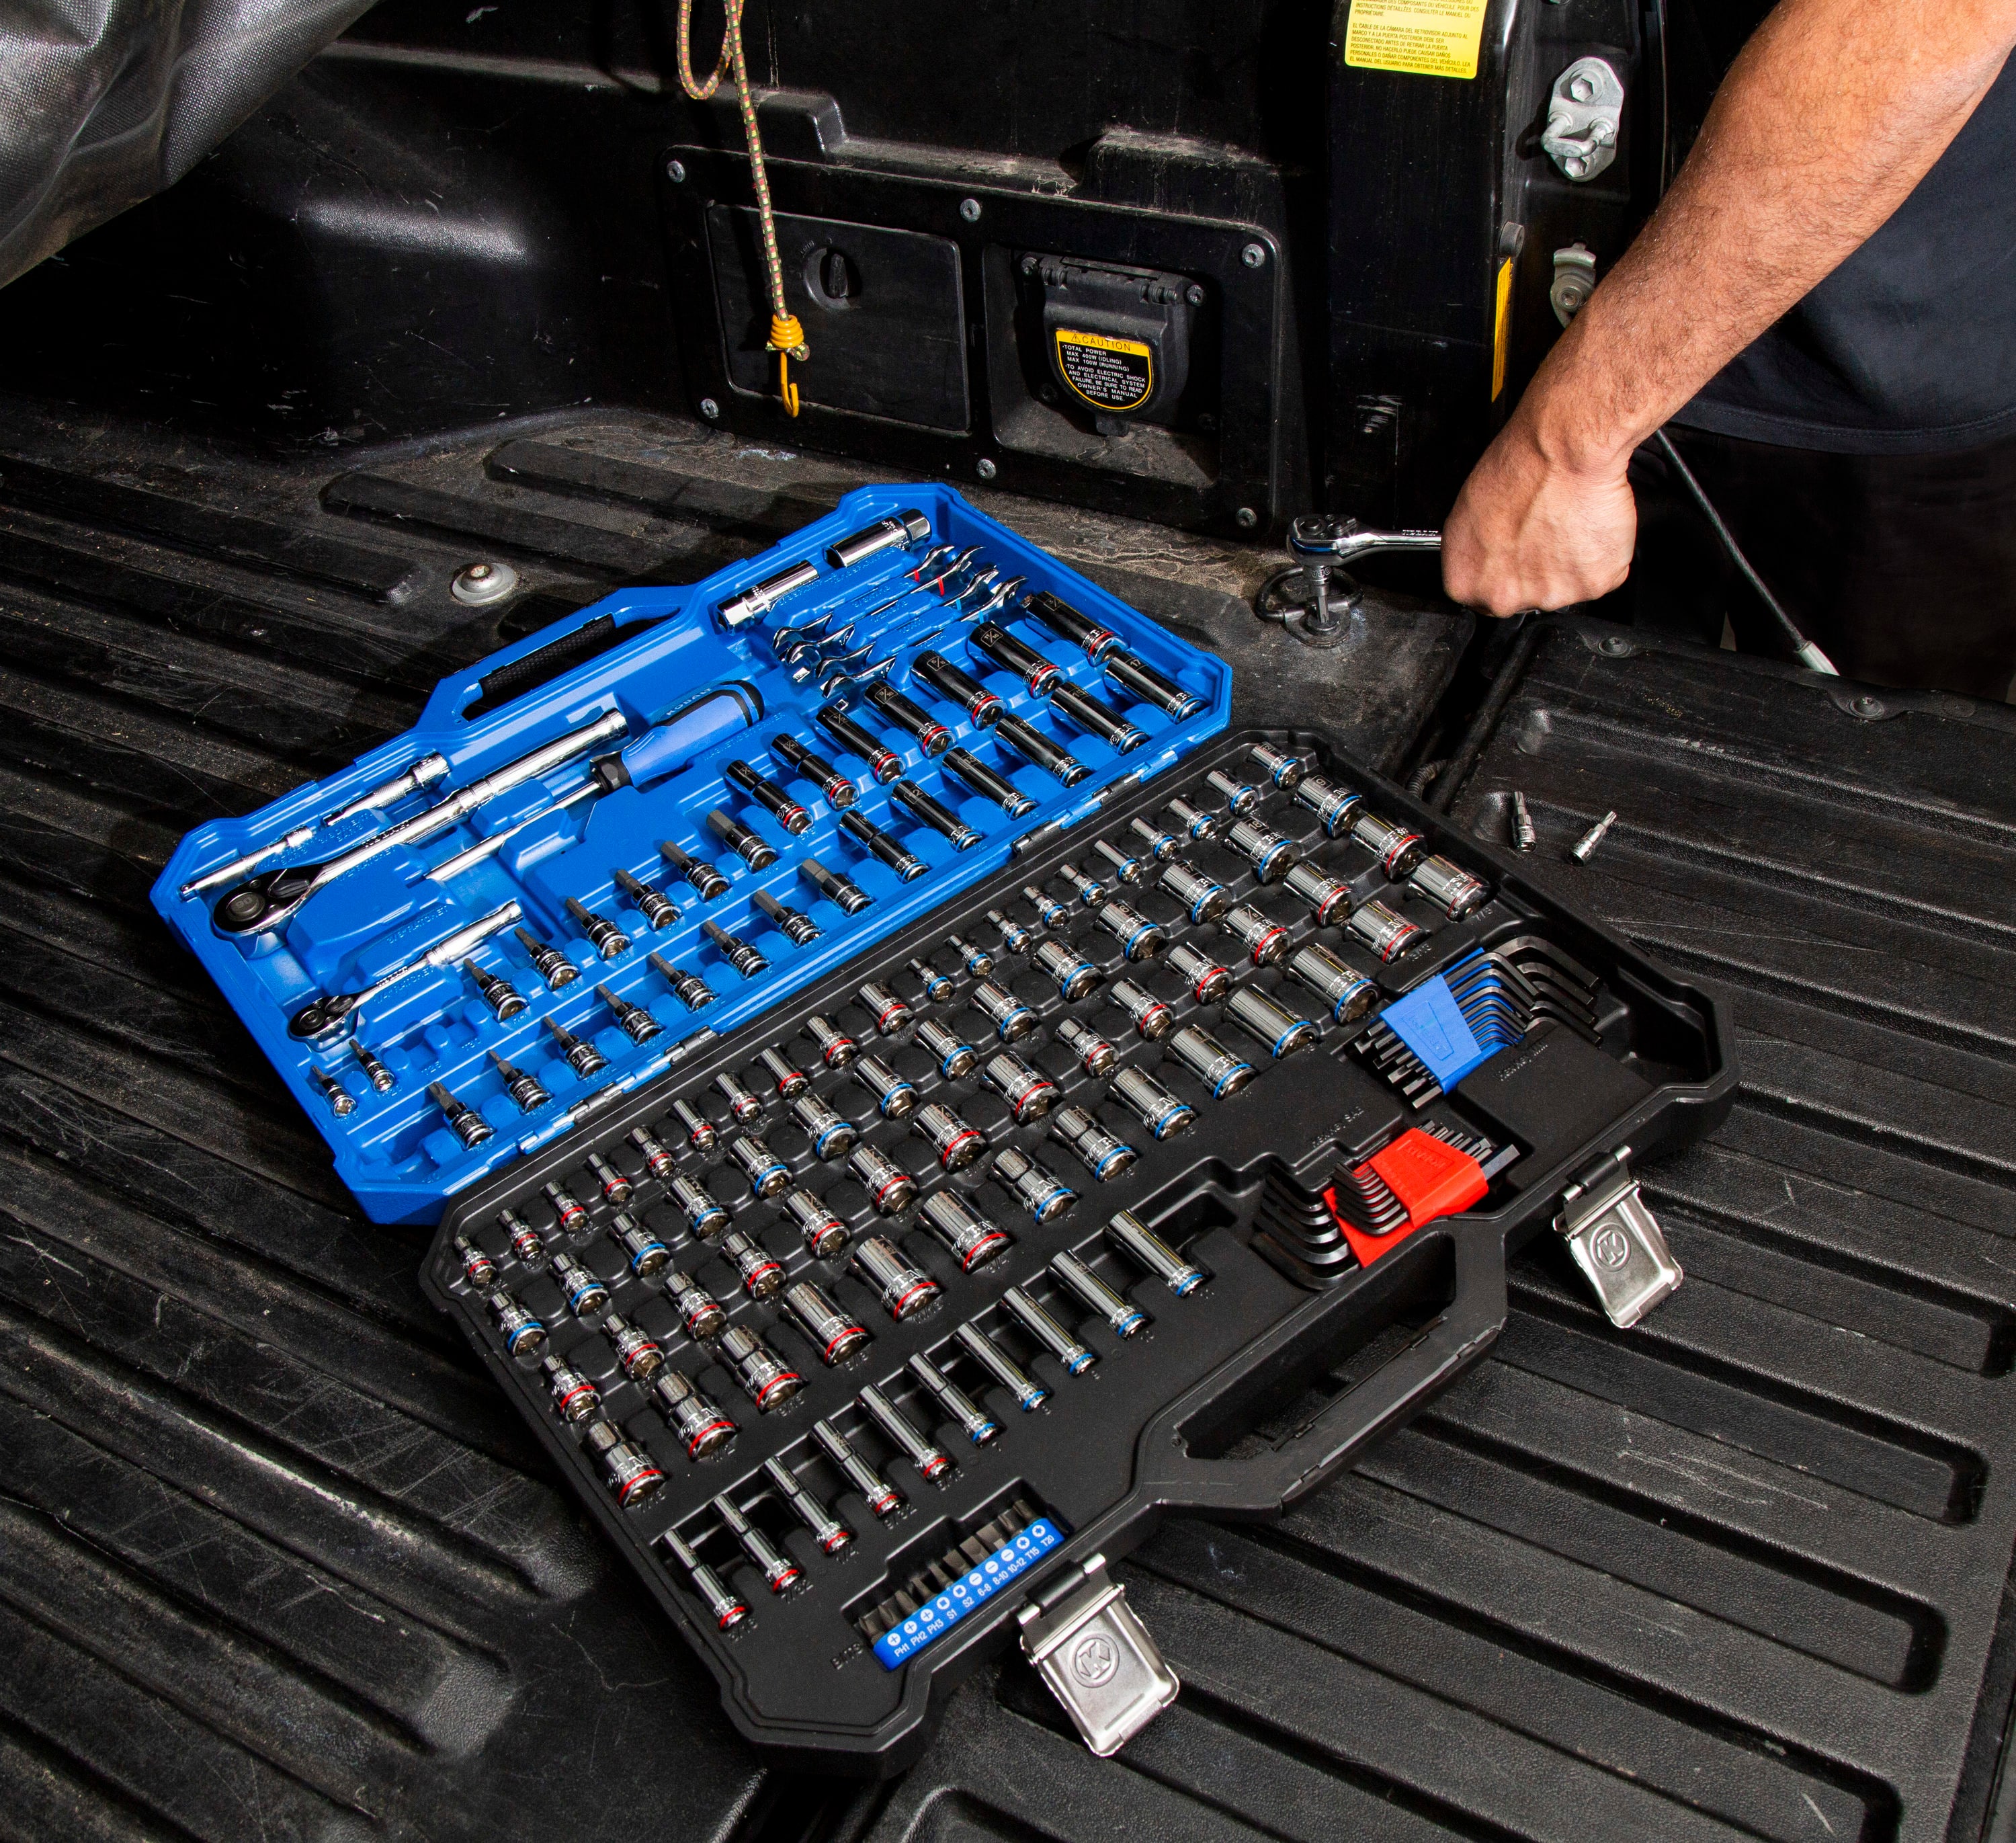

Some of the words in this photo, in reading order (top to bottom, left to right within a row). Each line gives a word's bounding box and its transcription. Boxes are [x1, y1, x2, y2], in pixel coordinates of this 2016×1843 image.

[1399, 34, 1422, 42] POSTERIOR
[1398, 54, 1429, 63] COMPONENTES
[1082, 336, 1130, 351] CAUTION
[1098, 356, 1122, 365] (IDLING)
[1099, 362, 1129, 372] (RUNNING)
[1083, 372, 1118, 383] ELECTRICAL
[1122, 380, 1144, 388] SYSTEM
[1097, 370, 1124, 378] ELECTRIC
[1127, 375, 1146, 383] SHOCK
[1077, 383, 1107, 392] OWNER'S
[1111, 389, 1137, 398] MANUAL
[1086, 390, 1108, 398] BEFORE
[894, 1644, 910, 1657] PH1
[911, 1631, 927, 1646] PH2
[927, 1620, 943, 1635] PH3
[947, 1610, 958, 1620] S1
[962, 1597, 974, 1608] S2
[977, 1584, 992, 1597] 6-8
[993, 1571, 1008, 1585] 8-10
[1008, 1558, 1027, 1573] 10-12
[1025, 1547, 1040, 1559] T15
[1040, 1534, 1054, 1547] T20
[831, 1643, 864, 1670] BITS
